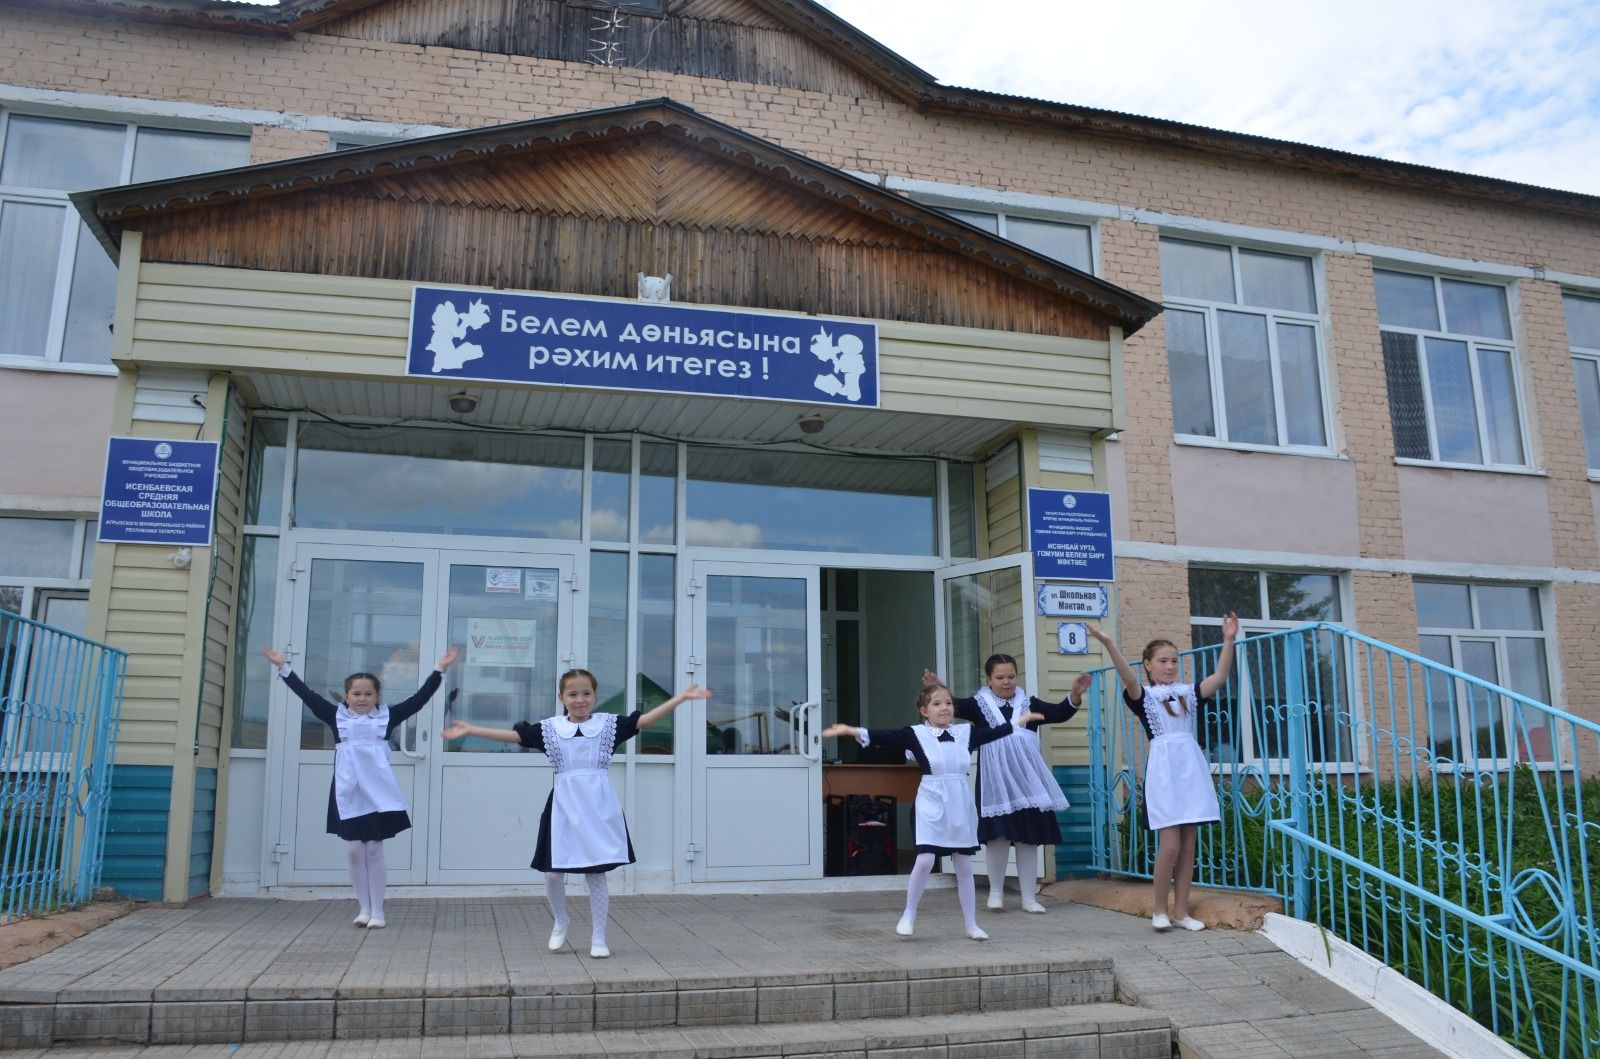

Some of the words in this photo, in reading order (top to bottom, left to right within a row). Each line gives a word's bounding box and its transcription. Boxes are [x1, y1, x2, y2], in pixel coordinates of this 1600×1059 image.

[501, 309, 608, 338] Белем
[619, 323, 801, 354] дөньясына
[529, 346, 638, 371] рәхим
[646, 354, 752, 379] итегез
[125, 483, 193, 493] ИСЕНБАЕВСКАЯ
[138, 493, 178, 501] СРЕДНЯЯ
[105, 500, 210, 511] ОБЩЕОБРАЗОВАТЕЛЬНАЯ
[141, 510, 172, 519] ШКОЛА
[1060, 590, 1097, 600] Школьная
[1058, 601, 1085, 611] Мәктәп
[1069, 632, 1076, 645] 8
